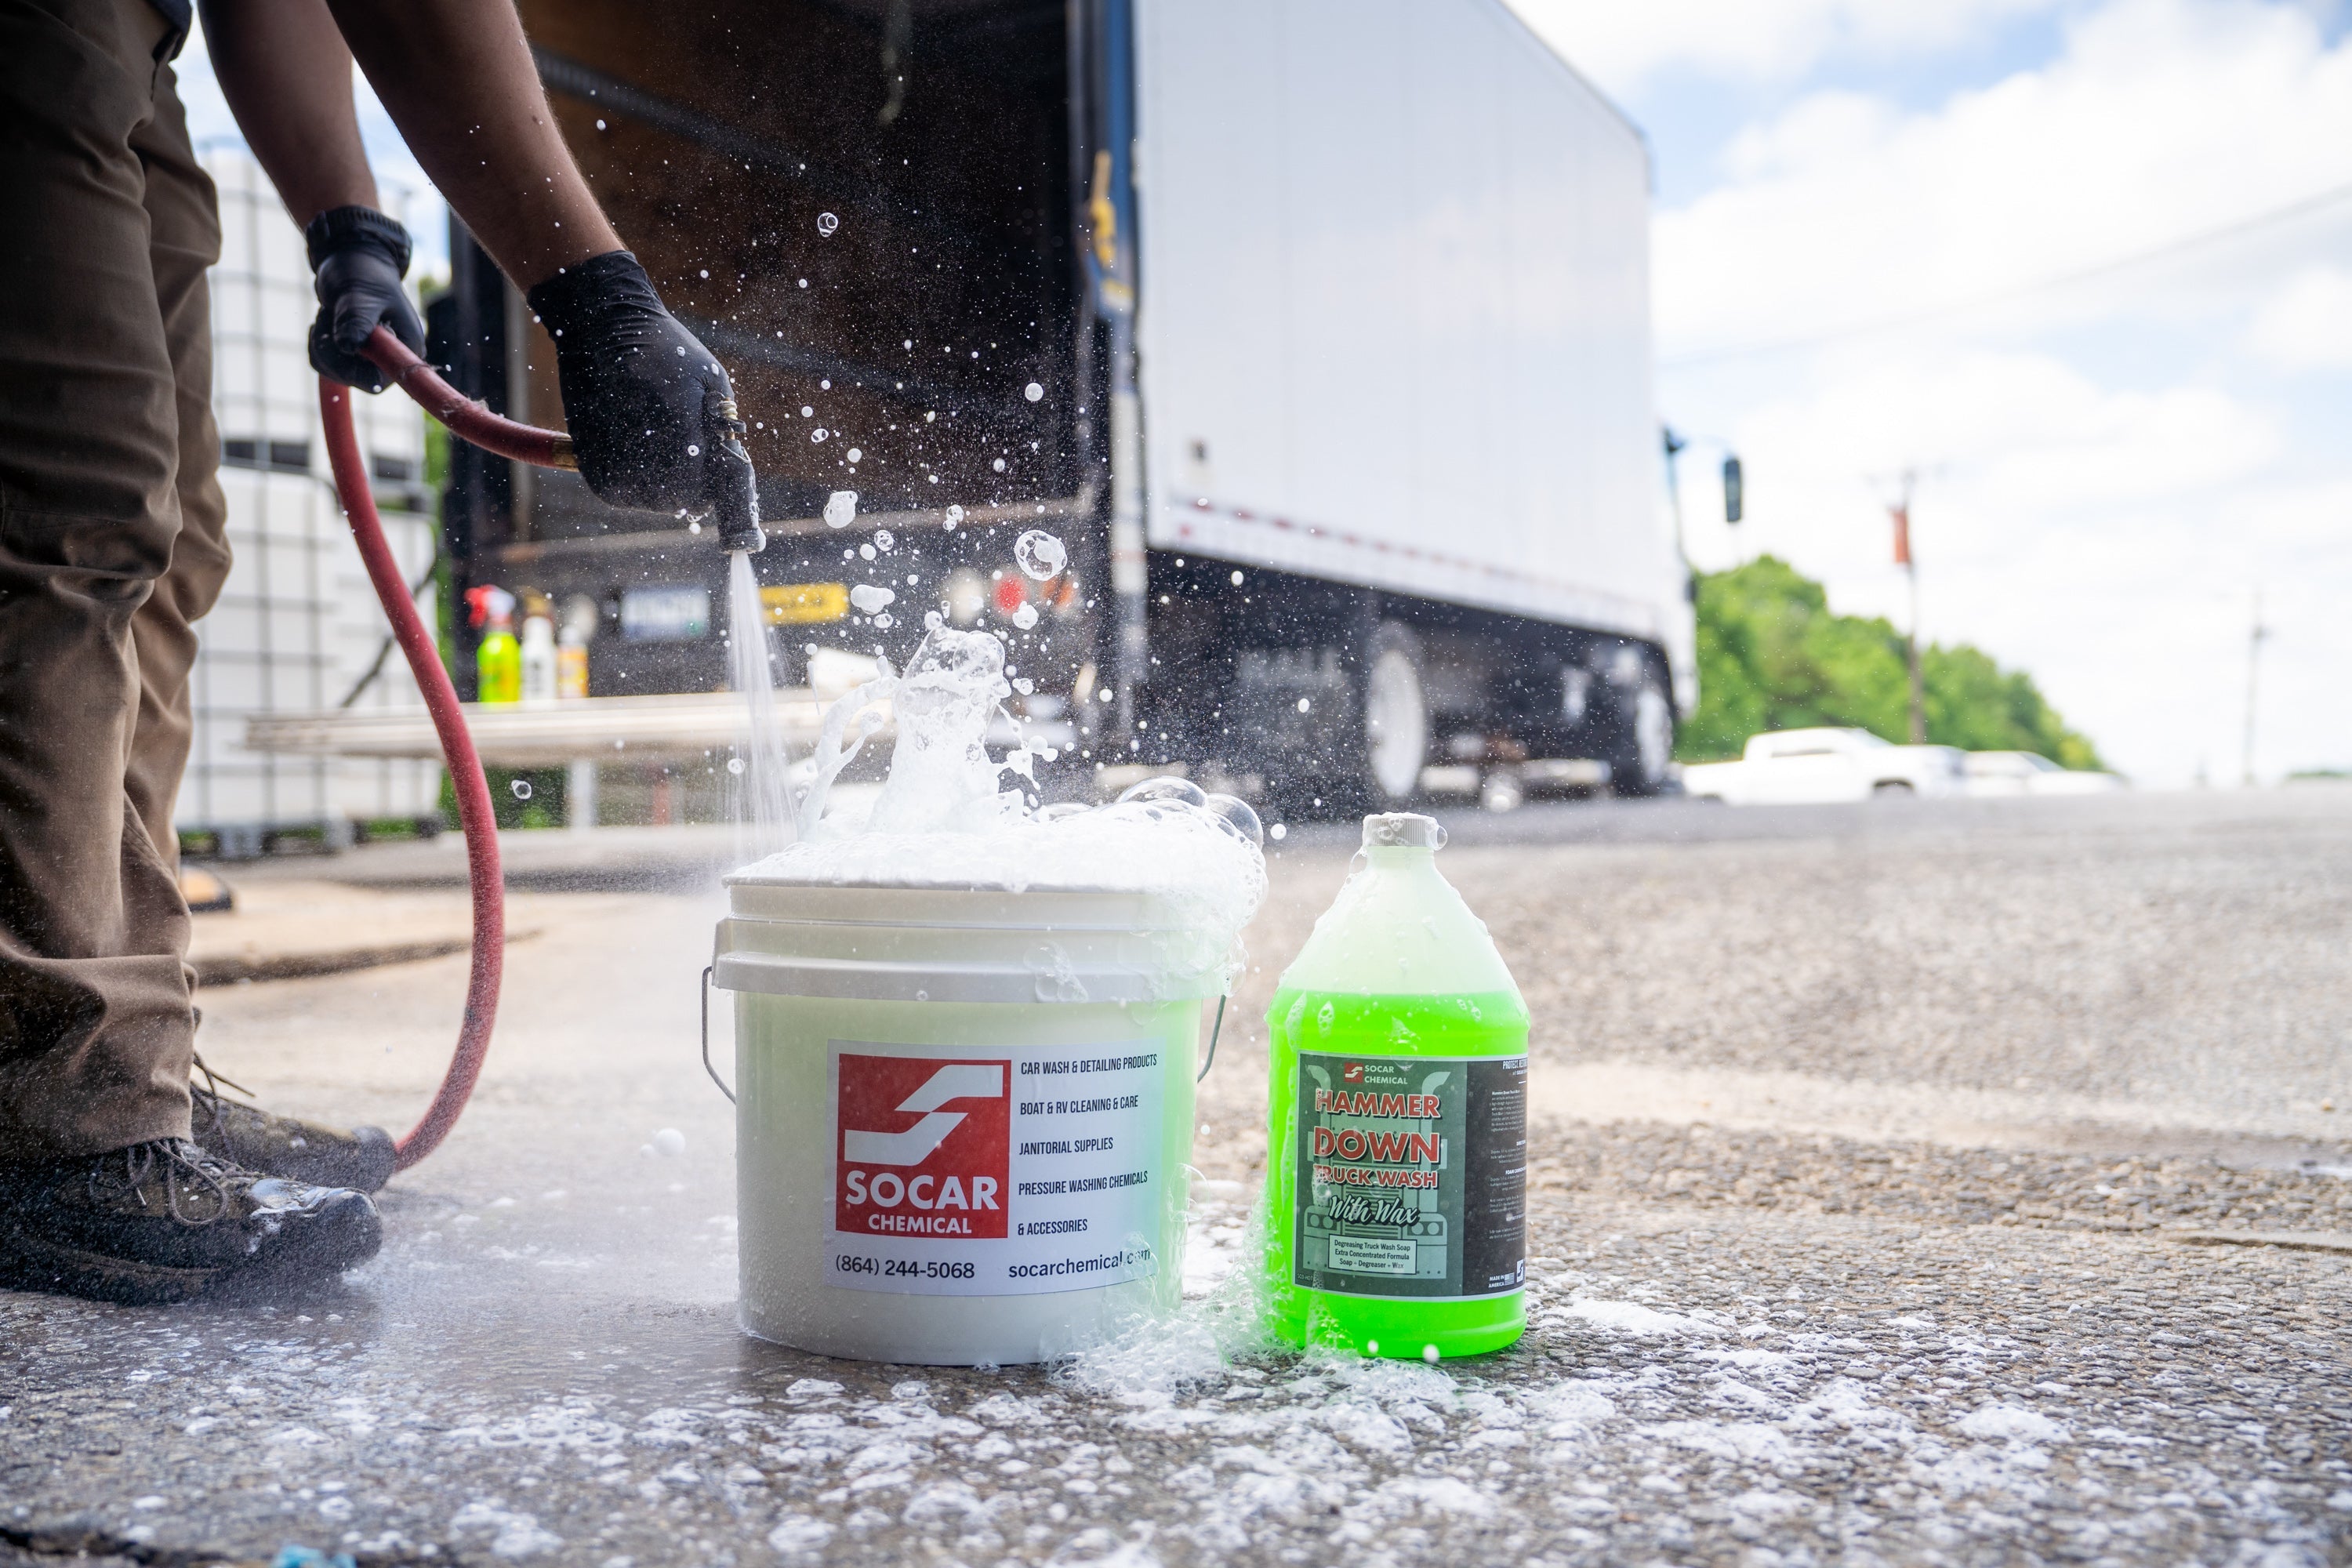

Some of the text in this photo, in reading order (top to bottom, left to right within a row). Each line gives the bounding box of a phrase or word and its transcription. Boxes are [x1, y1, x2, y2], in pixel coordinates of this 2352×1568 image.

[1021, 1054, 1157, 1075] CAR WASH & DETAILING PRODUCTS
[1021, 1095, 1138, 1115] BOAT & RV CLEANING & CARE
[1316, 1087, 1441, 1118] HAMMER
[1019, 1137, 1113, 1155] JANITORIAL SUPPLIES
[1314, 1126, 1439, 1163] DOWN
[1019, 1171, 1148, 1195] PRESSURE WASHING CHEMICALS
[1313, 1163, 1438, 1188] TRUCK WASH
[845, 1170, 1000, 1210] SOCAR
[1330, 1194, 1417, 1225] With Wax
[869, 1214, 972, 1233] CHEMICAL
[1018, 1219, 1087, 1236] & ACCESSORIES
[1334, 1240, 1363, 1249] Degreasing
[837, 1254, 975, 1278] (864) 244-5068
